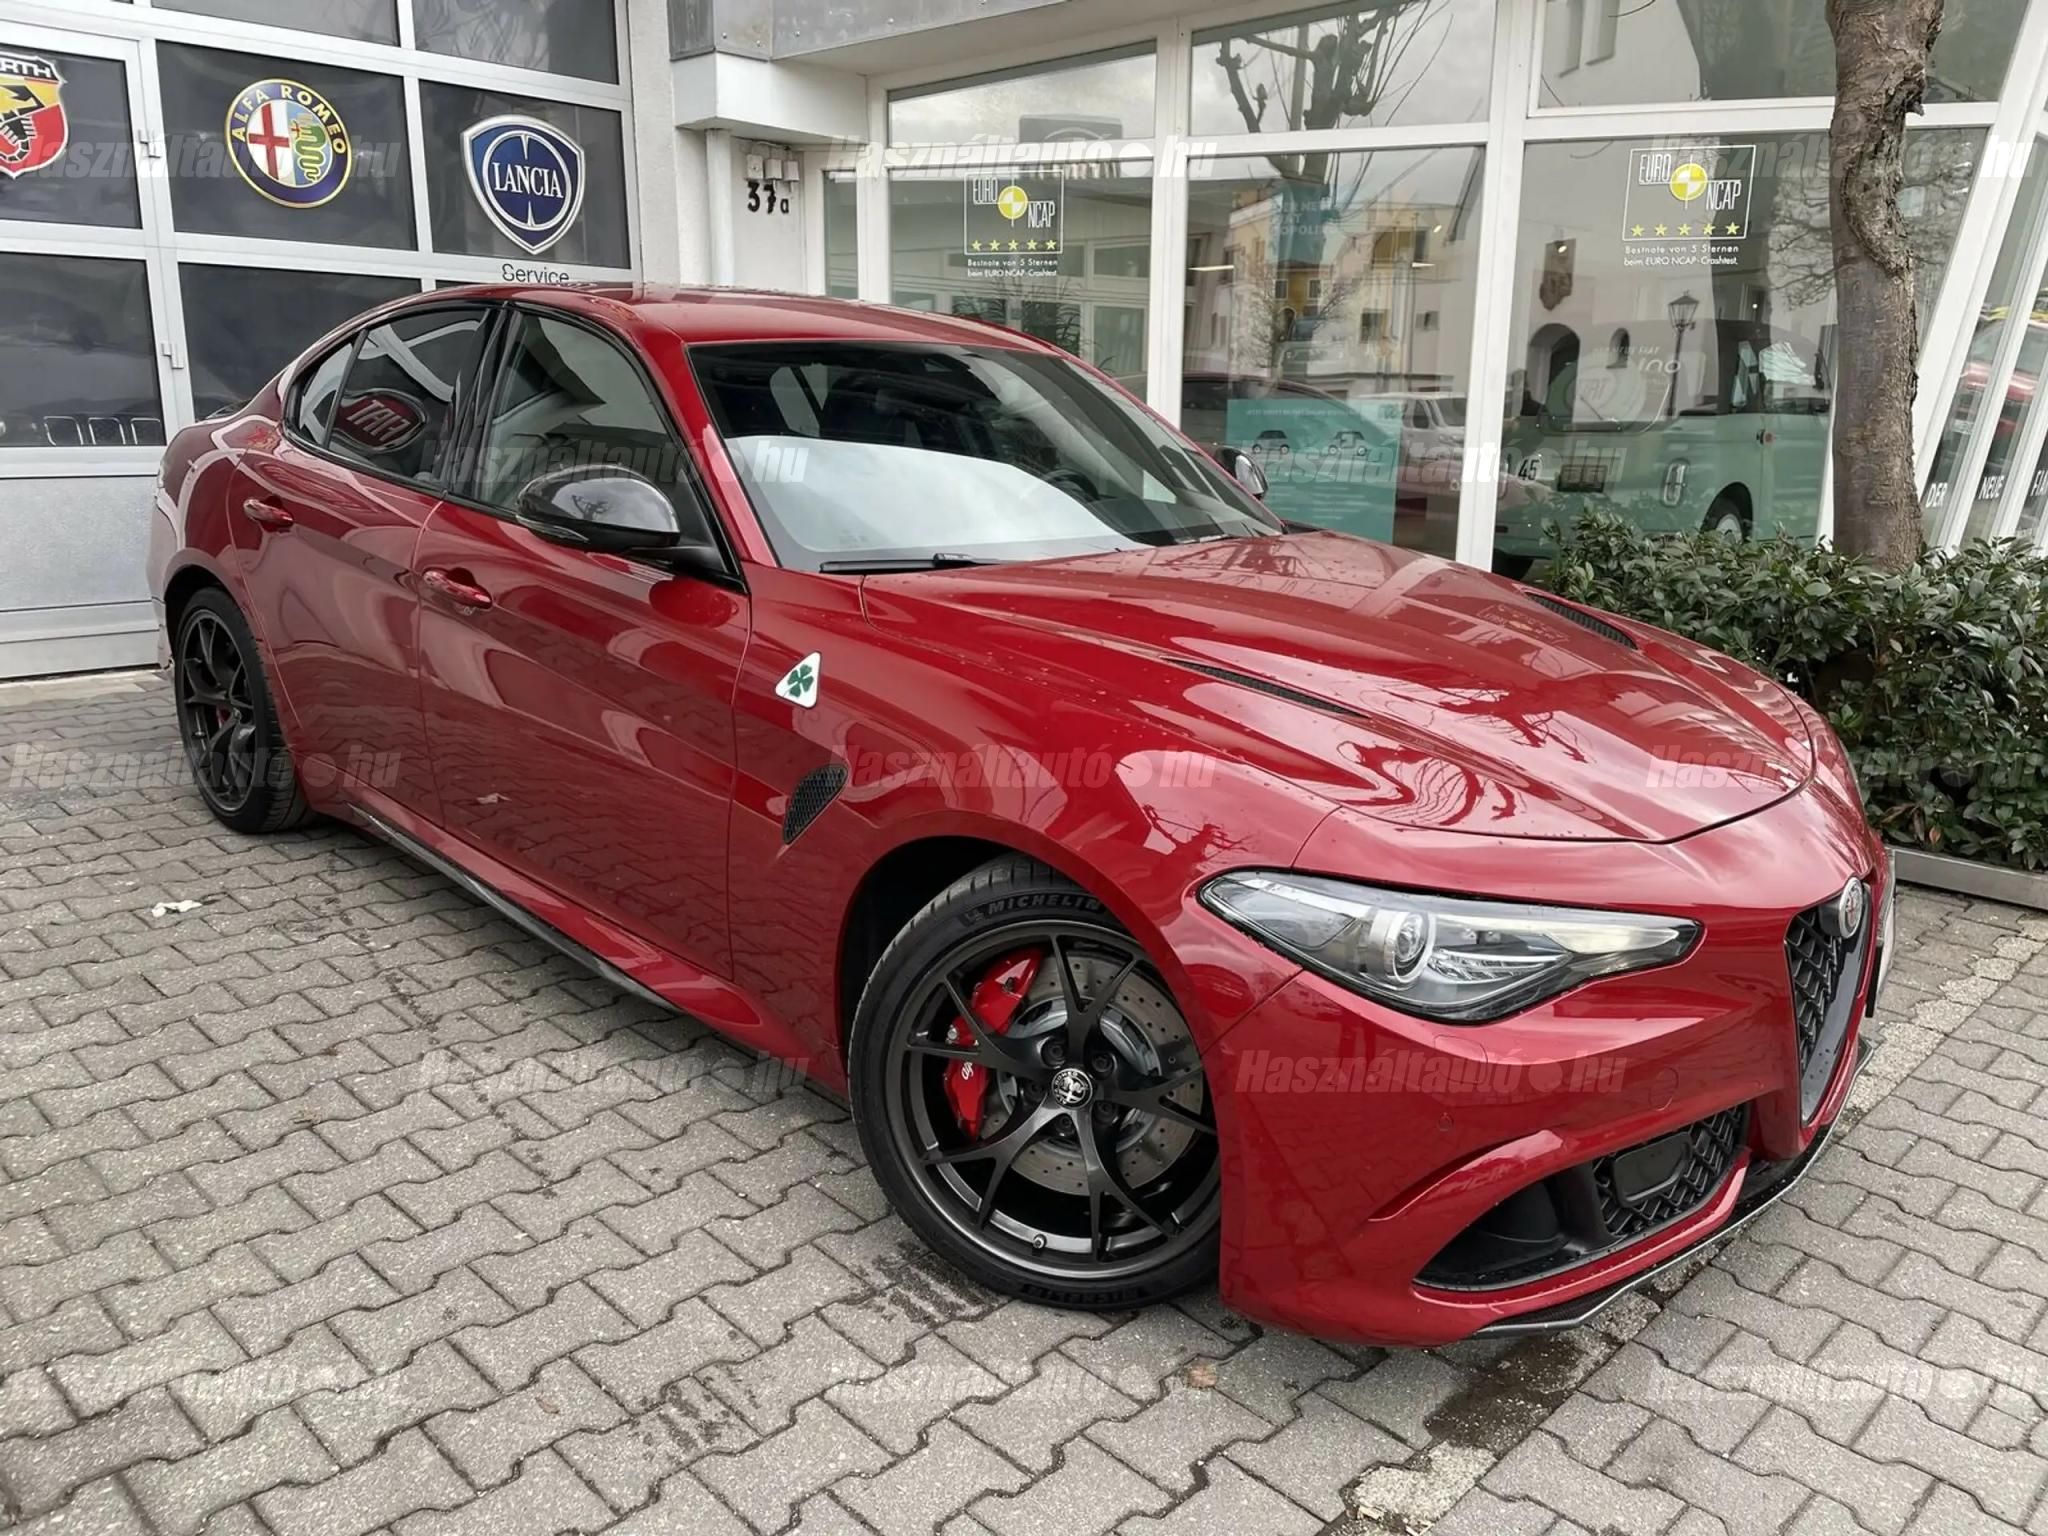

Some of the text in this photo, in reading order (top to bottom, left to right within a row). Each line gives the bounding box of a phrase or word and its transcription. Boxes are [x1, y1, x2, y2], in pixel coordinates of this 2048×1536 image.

[231, 84, 347, 154] ALFA ROMEO
[492, 161, 564, 199] LANCIA
[1639, 154, 1741, 210] EURO NCAP
[1027, 200, 1055, 228] NCAP
[1625, 246, 1664, 254] Bestnote
[1690, 245, 1697, 253] 5
[1702, 244, 1739, 253] Sternen
[967, 258, 999, 267] Bestnote
[1020, 259, 1025, 267] 5
[1028, 258, 1058, 267] Sternen
[1624, 257, 1642, 266] beim
[1645, 256, 1669, 265] EURO
[501, 263, 570, 284] Service
[988, 894, 1102, 915] MICHELIN
